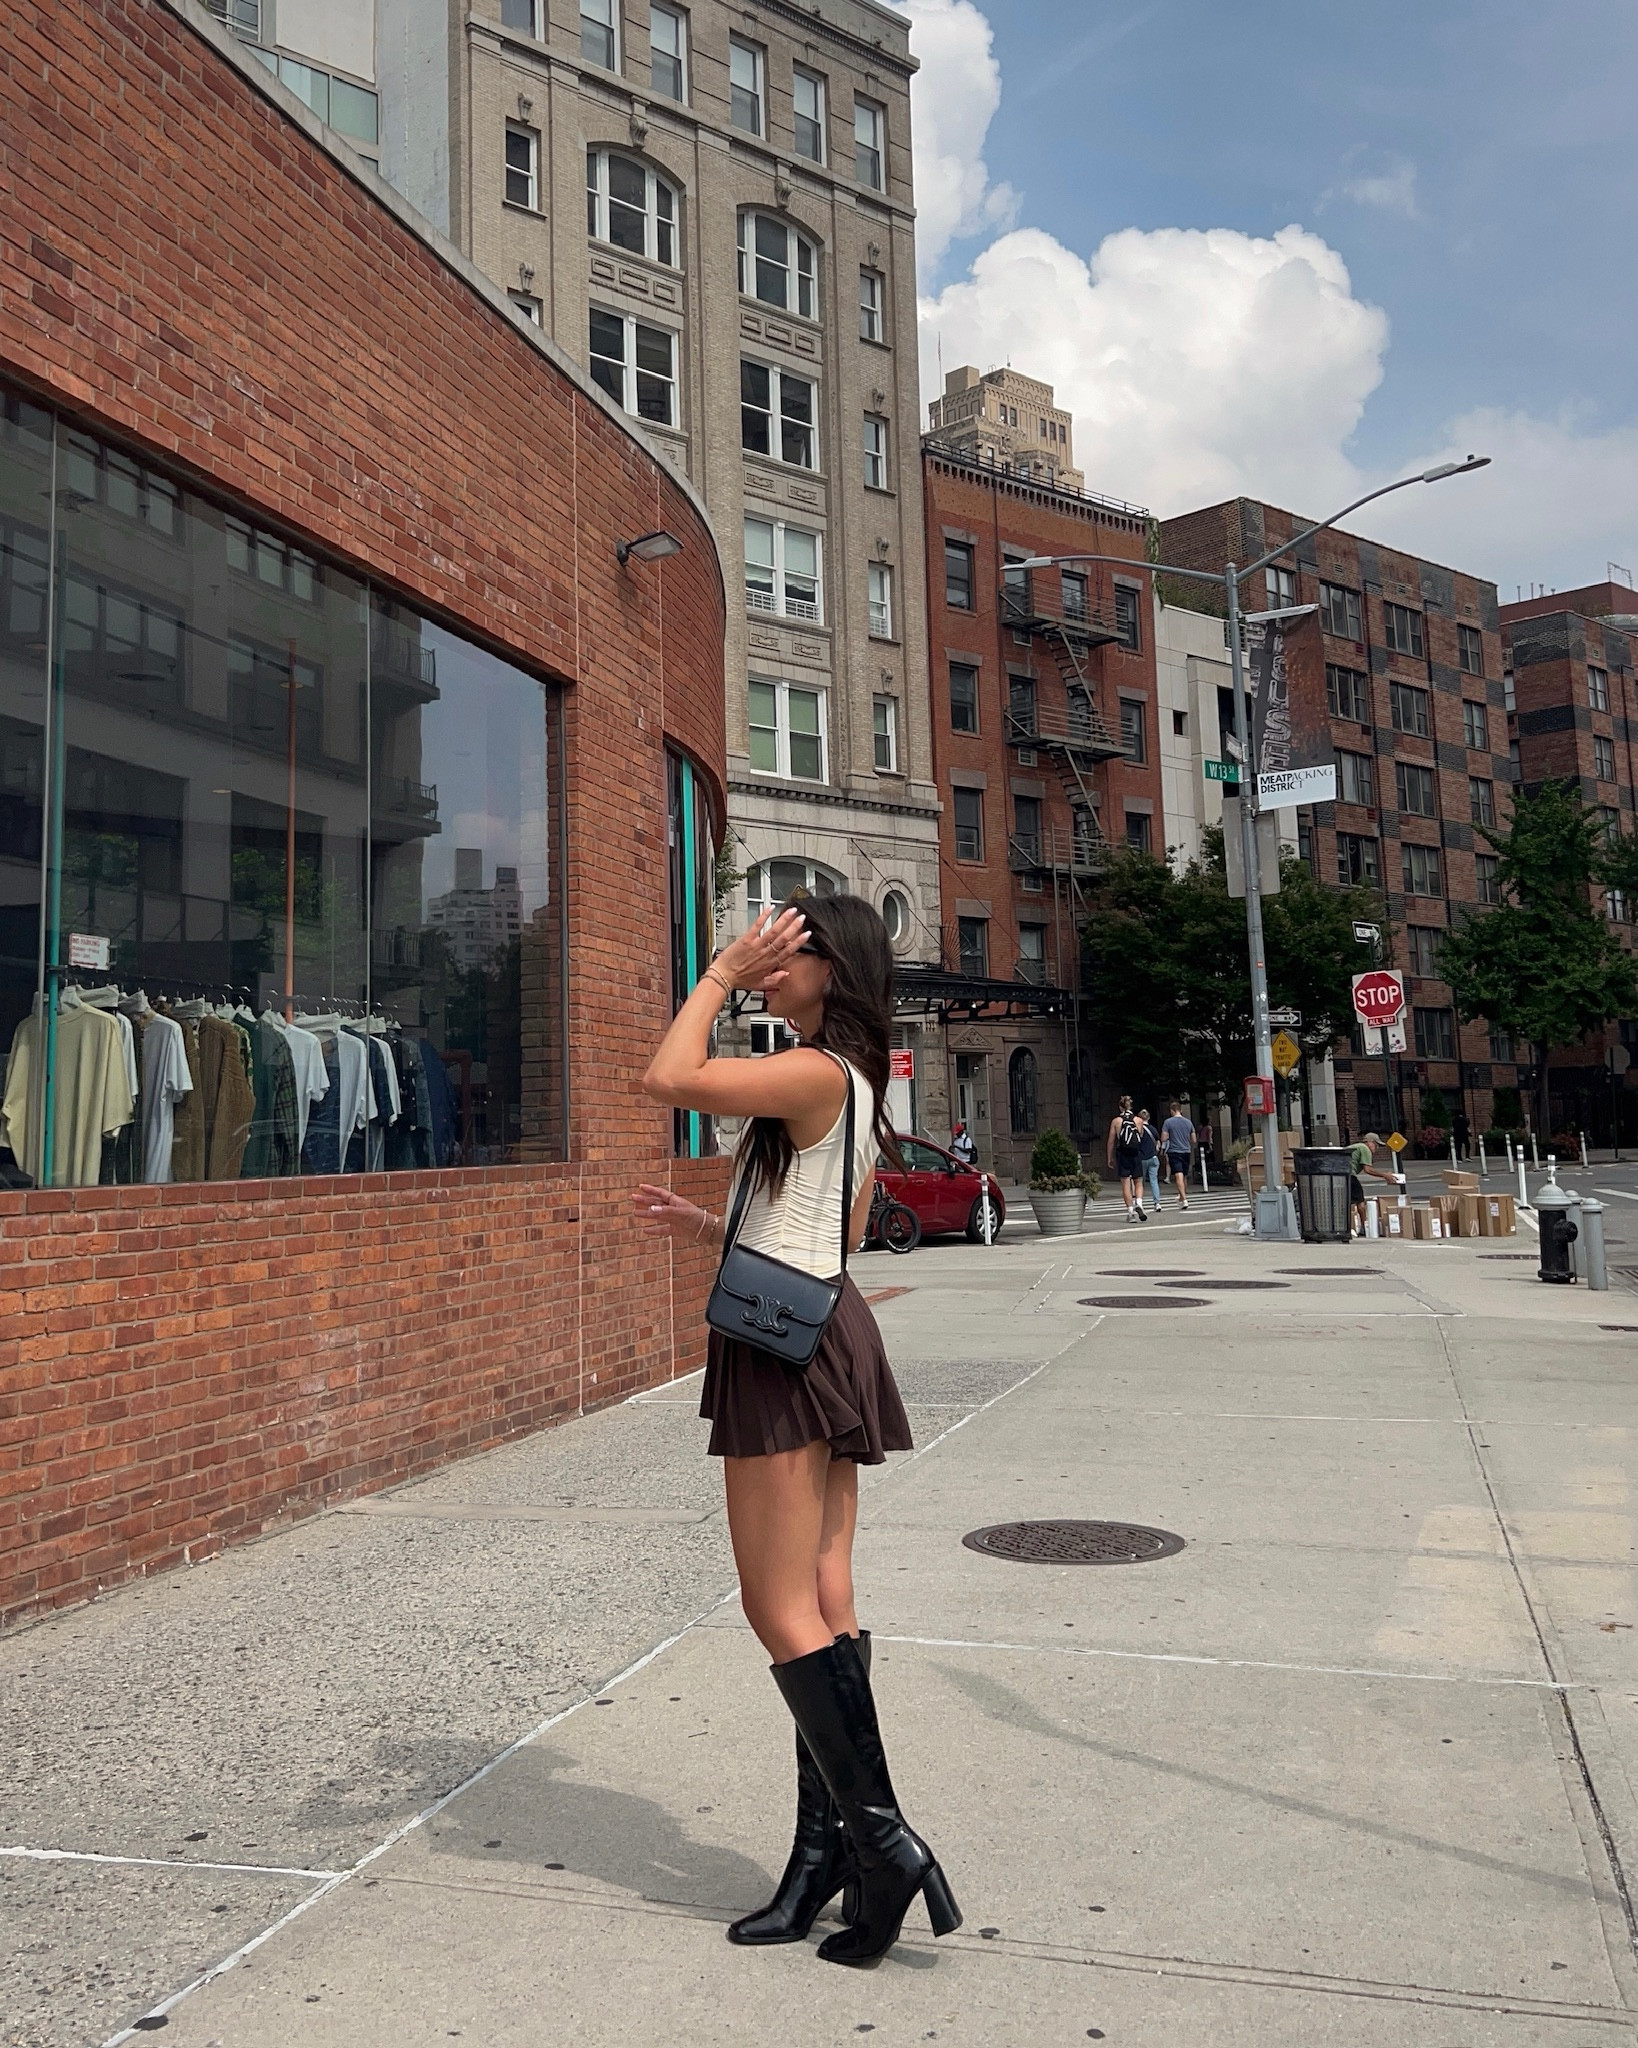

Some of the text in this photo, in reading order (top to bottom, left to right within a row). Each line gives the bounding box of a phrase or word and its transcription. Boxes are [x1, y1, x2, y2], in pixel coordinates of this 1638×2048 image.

[1209, 763, 1218, 778] W
[1219, 766, 1228, 779] 13
[1260, 767, 1333, 785] MEATPACKING
[1261, 780, 1303, 794] DISTRICT
[1357, 985, 1400, 1008] STOP
[1368, 1016, 1395, 1025] ALL WAY
